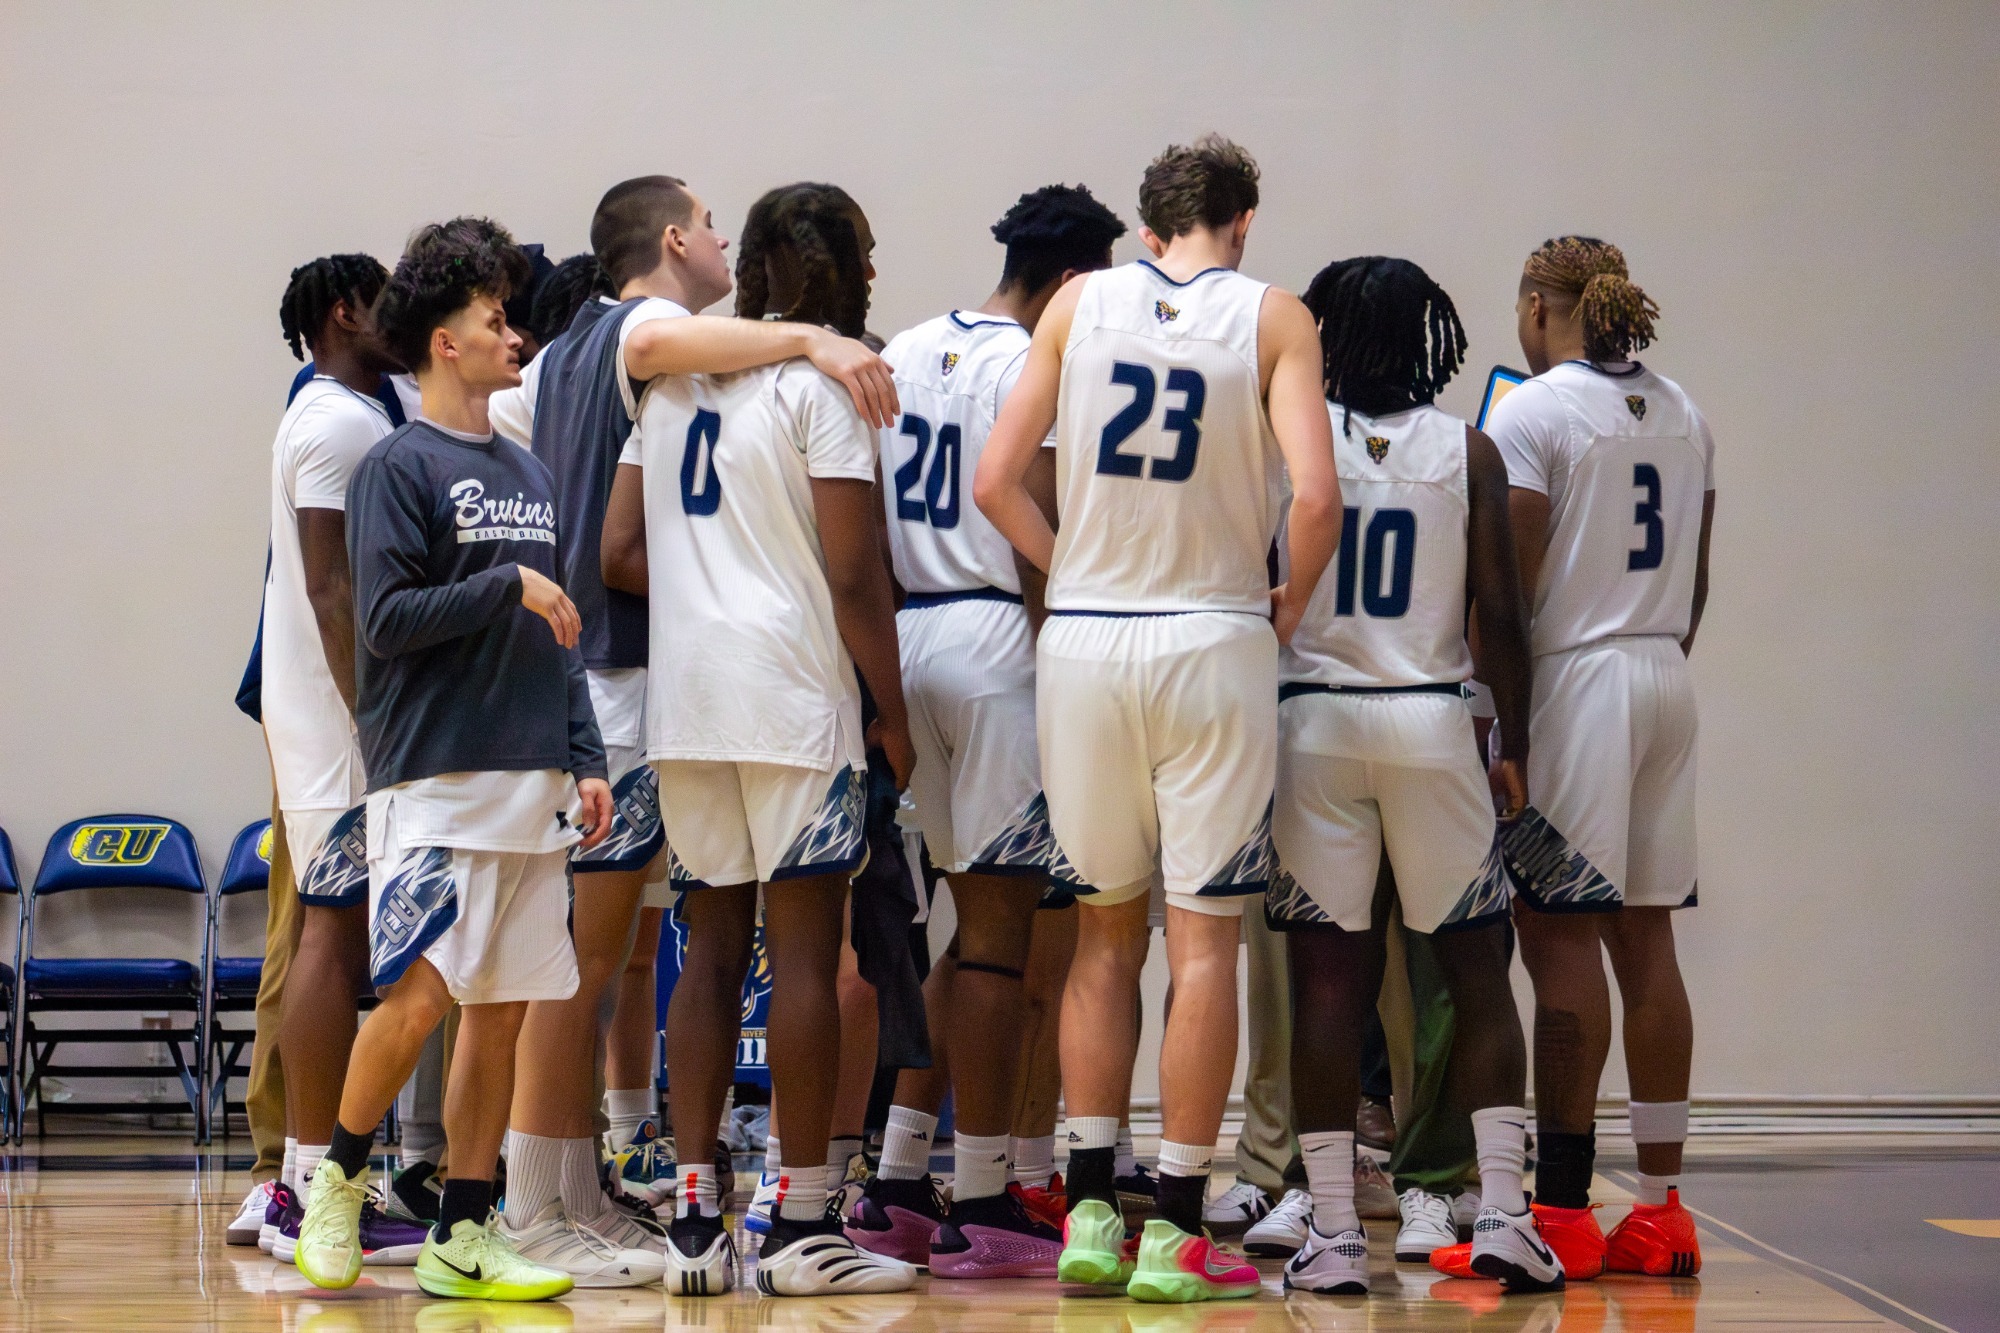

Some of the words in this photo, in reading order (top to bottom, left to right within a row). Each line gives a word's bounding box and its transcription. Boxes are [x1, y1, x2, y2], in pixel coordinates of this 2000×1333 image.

[680, 405, 722, 518] 0
[894, 411, 962, 531] 20
[1095, 359, 1207, 484] 23
[450, 479, 556, 528] Bruins
[1627, 462, 1664, 573] 3
[1334, 505, 1418, 620] 10
[78, 825, 171, 866] CU
